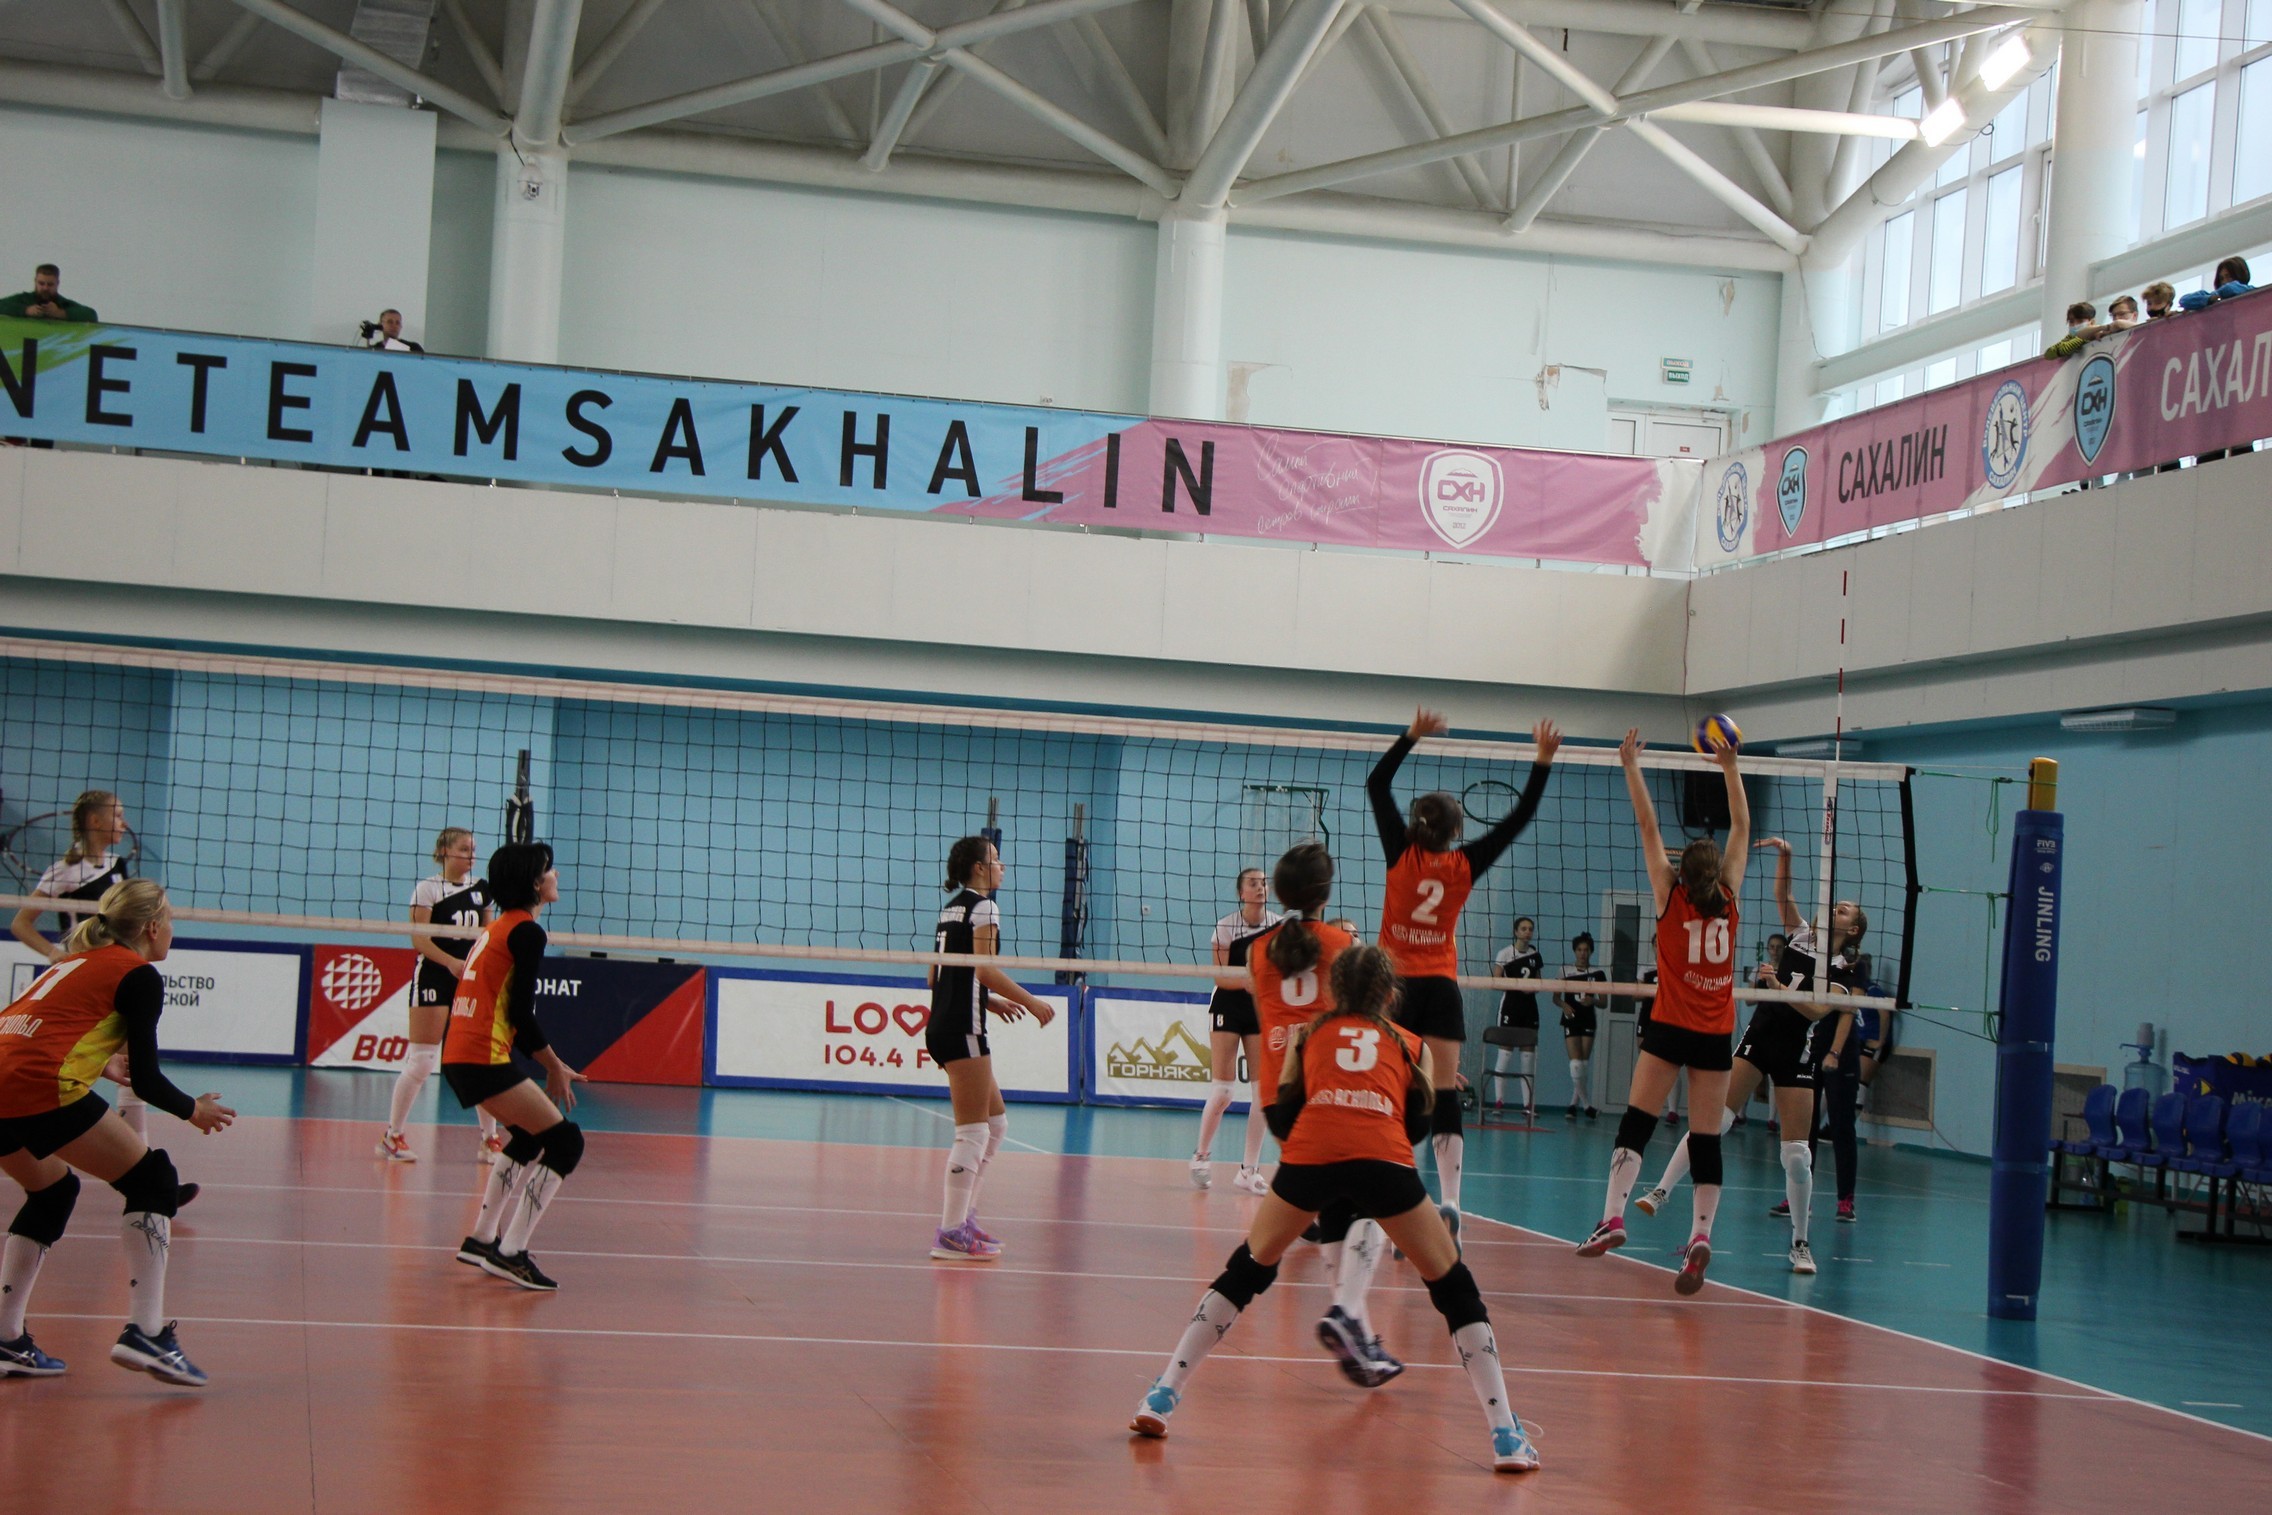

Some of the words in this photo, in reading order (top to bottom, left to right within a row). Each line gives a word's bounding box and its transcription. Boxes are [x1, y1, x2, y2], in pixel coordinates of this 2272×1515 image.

[2160, 330, 2272, 422] САХАЛ
[1838, 423, 1948, 504] САХАЛИН
[1411, 878, 1444, 926] 2
[2035, 885, 2055, 963] JINLING
[1682, 917, 1730, 964] 10
[422, 988, 437, 1002] 10
[825, 1044, 904, 1068] 104.4
[1334, 1026, 1381, 1072] 3
